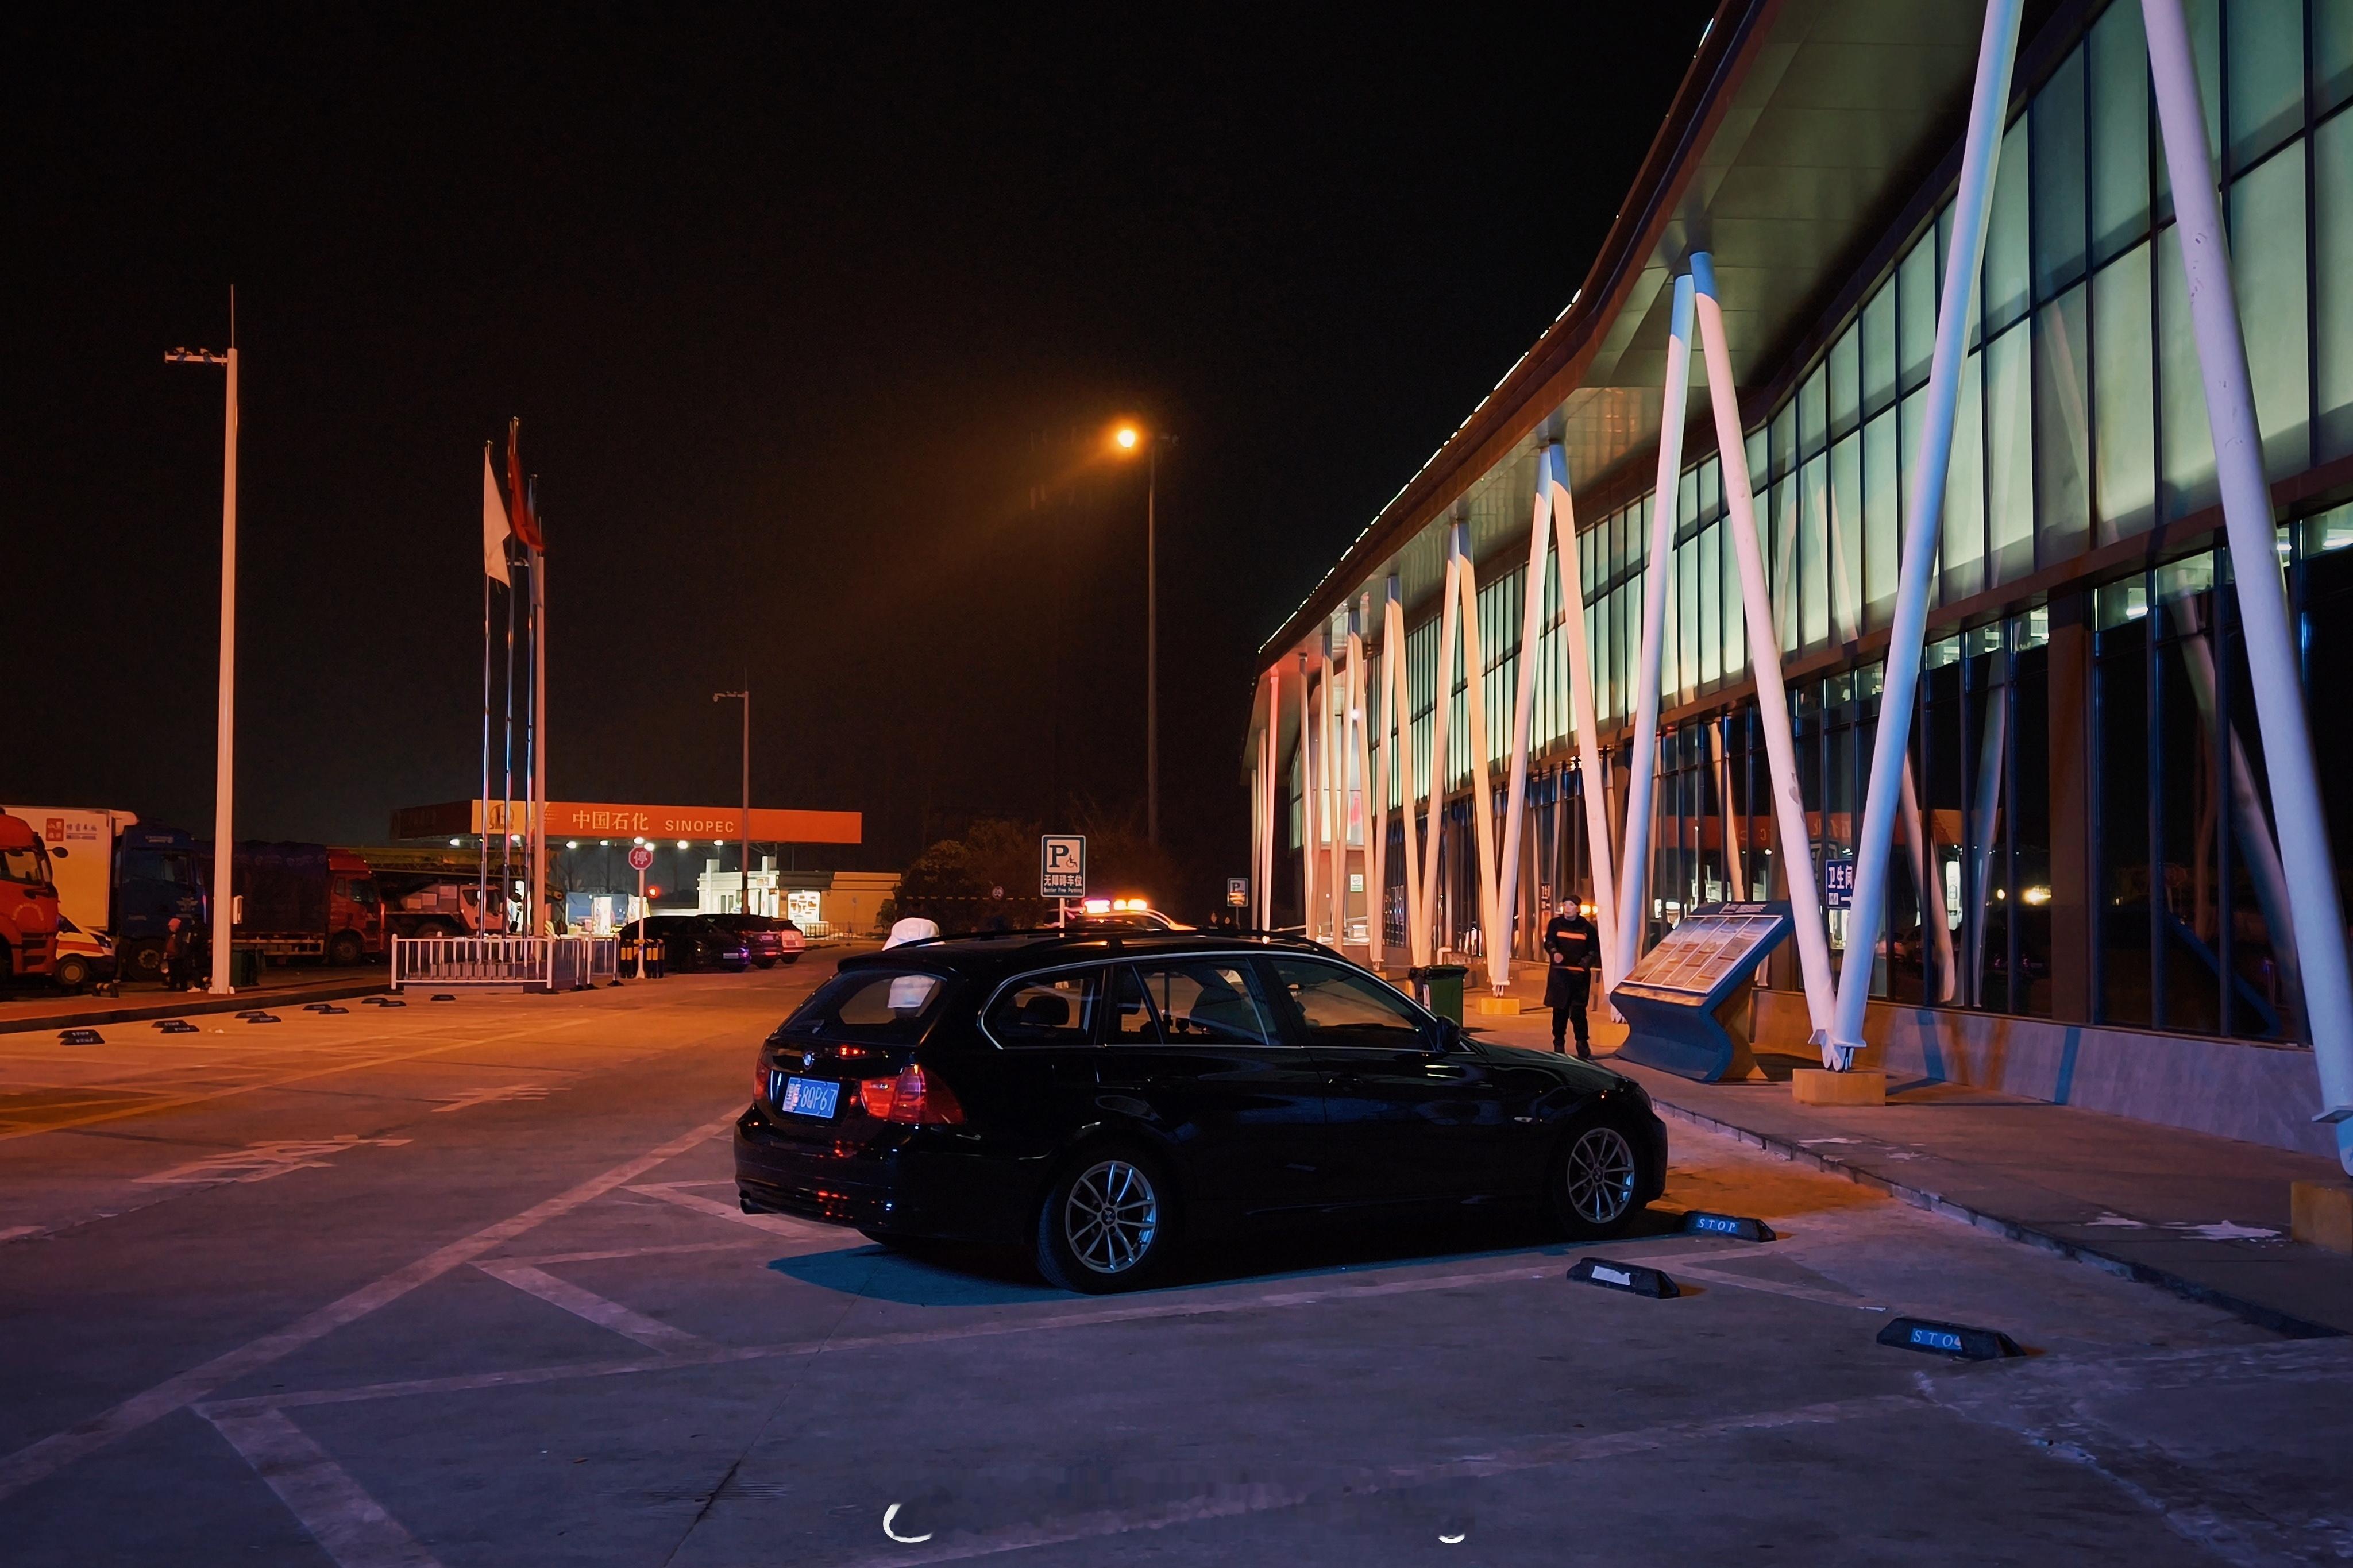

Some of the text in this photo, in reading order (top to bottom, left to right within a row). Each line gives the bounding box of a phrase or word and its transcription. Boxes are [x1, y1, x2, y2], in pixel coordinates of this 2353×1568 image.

[572, 810, 649, 831] 中国石化
[665, 820, 734, 832] SINOPEC
[1049, 845, 1069, 867] P
[1044, 875, 1082, 886] 无障碍车位
[1828, 865, 1853, 889] 卫生间
[1699, 1218, 1735, 1232] STOP
[1914, 1330, 1954, 1347] STO
